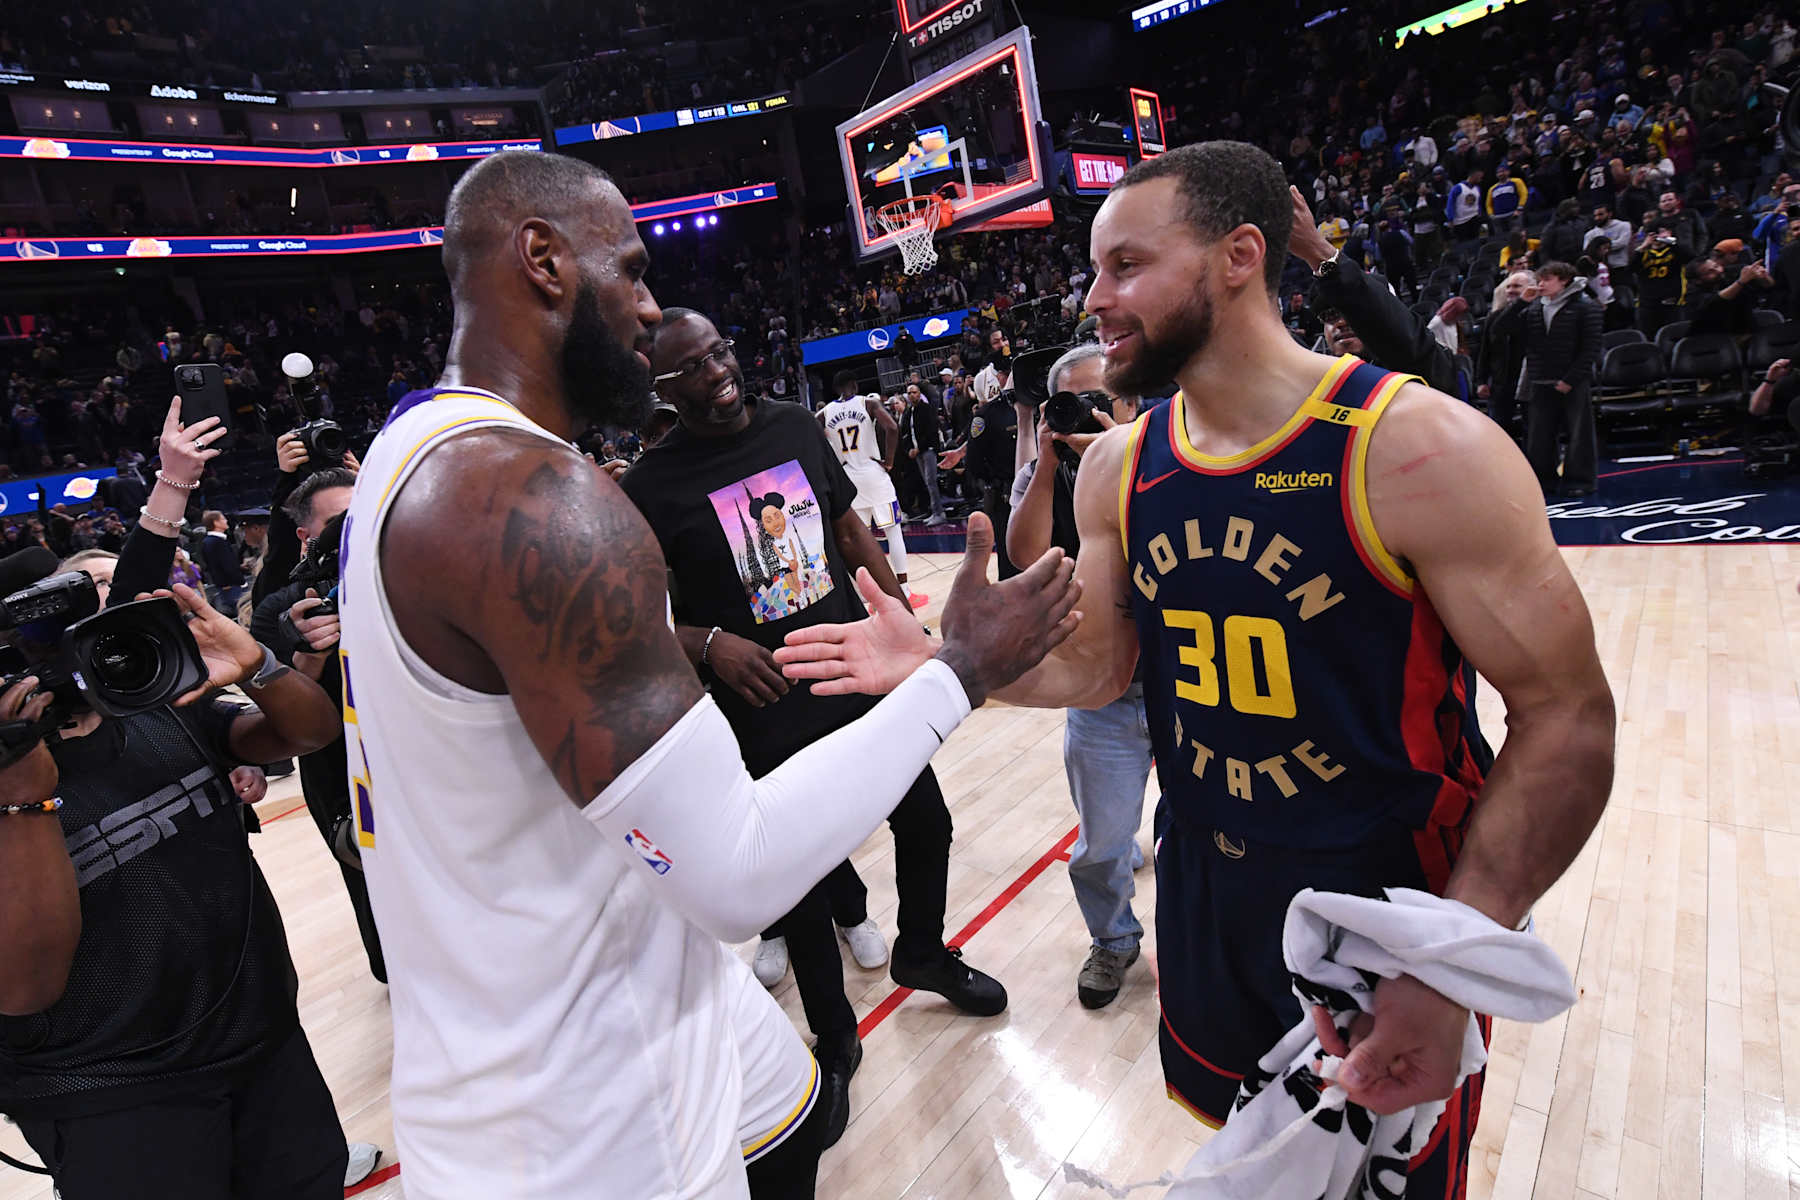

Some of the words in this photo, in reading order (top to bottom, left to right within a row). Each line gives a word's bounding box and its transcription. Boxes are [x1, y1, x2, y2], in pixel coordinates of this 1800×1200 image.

[927, 0, 983, 38] TISSOT
[63, 79, 111, 91] verizon
[150, 85, 198, 100] Adobe
[223, 92, 278, 104] ticketmaster
[765, 96, 788, 107] FINAL
[1330, 408, 1350, 422] 16
[837, 424, 860, 453] 17
[1254, 470, 1334, 490] Rakuten
[1132, 515, 1347, 622] GOLDEN
[1161, 608, 1298, 719] 30
